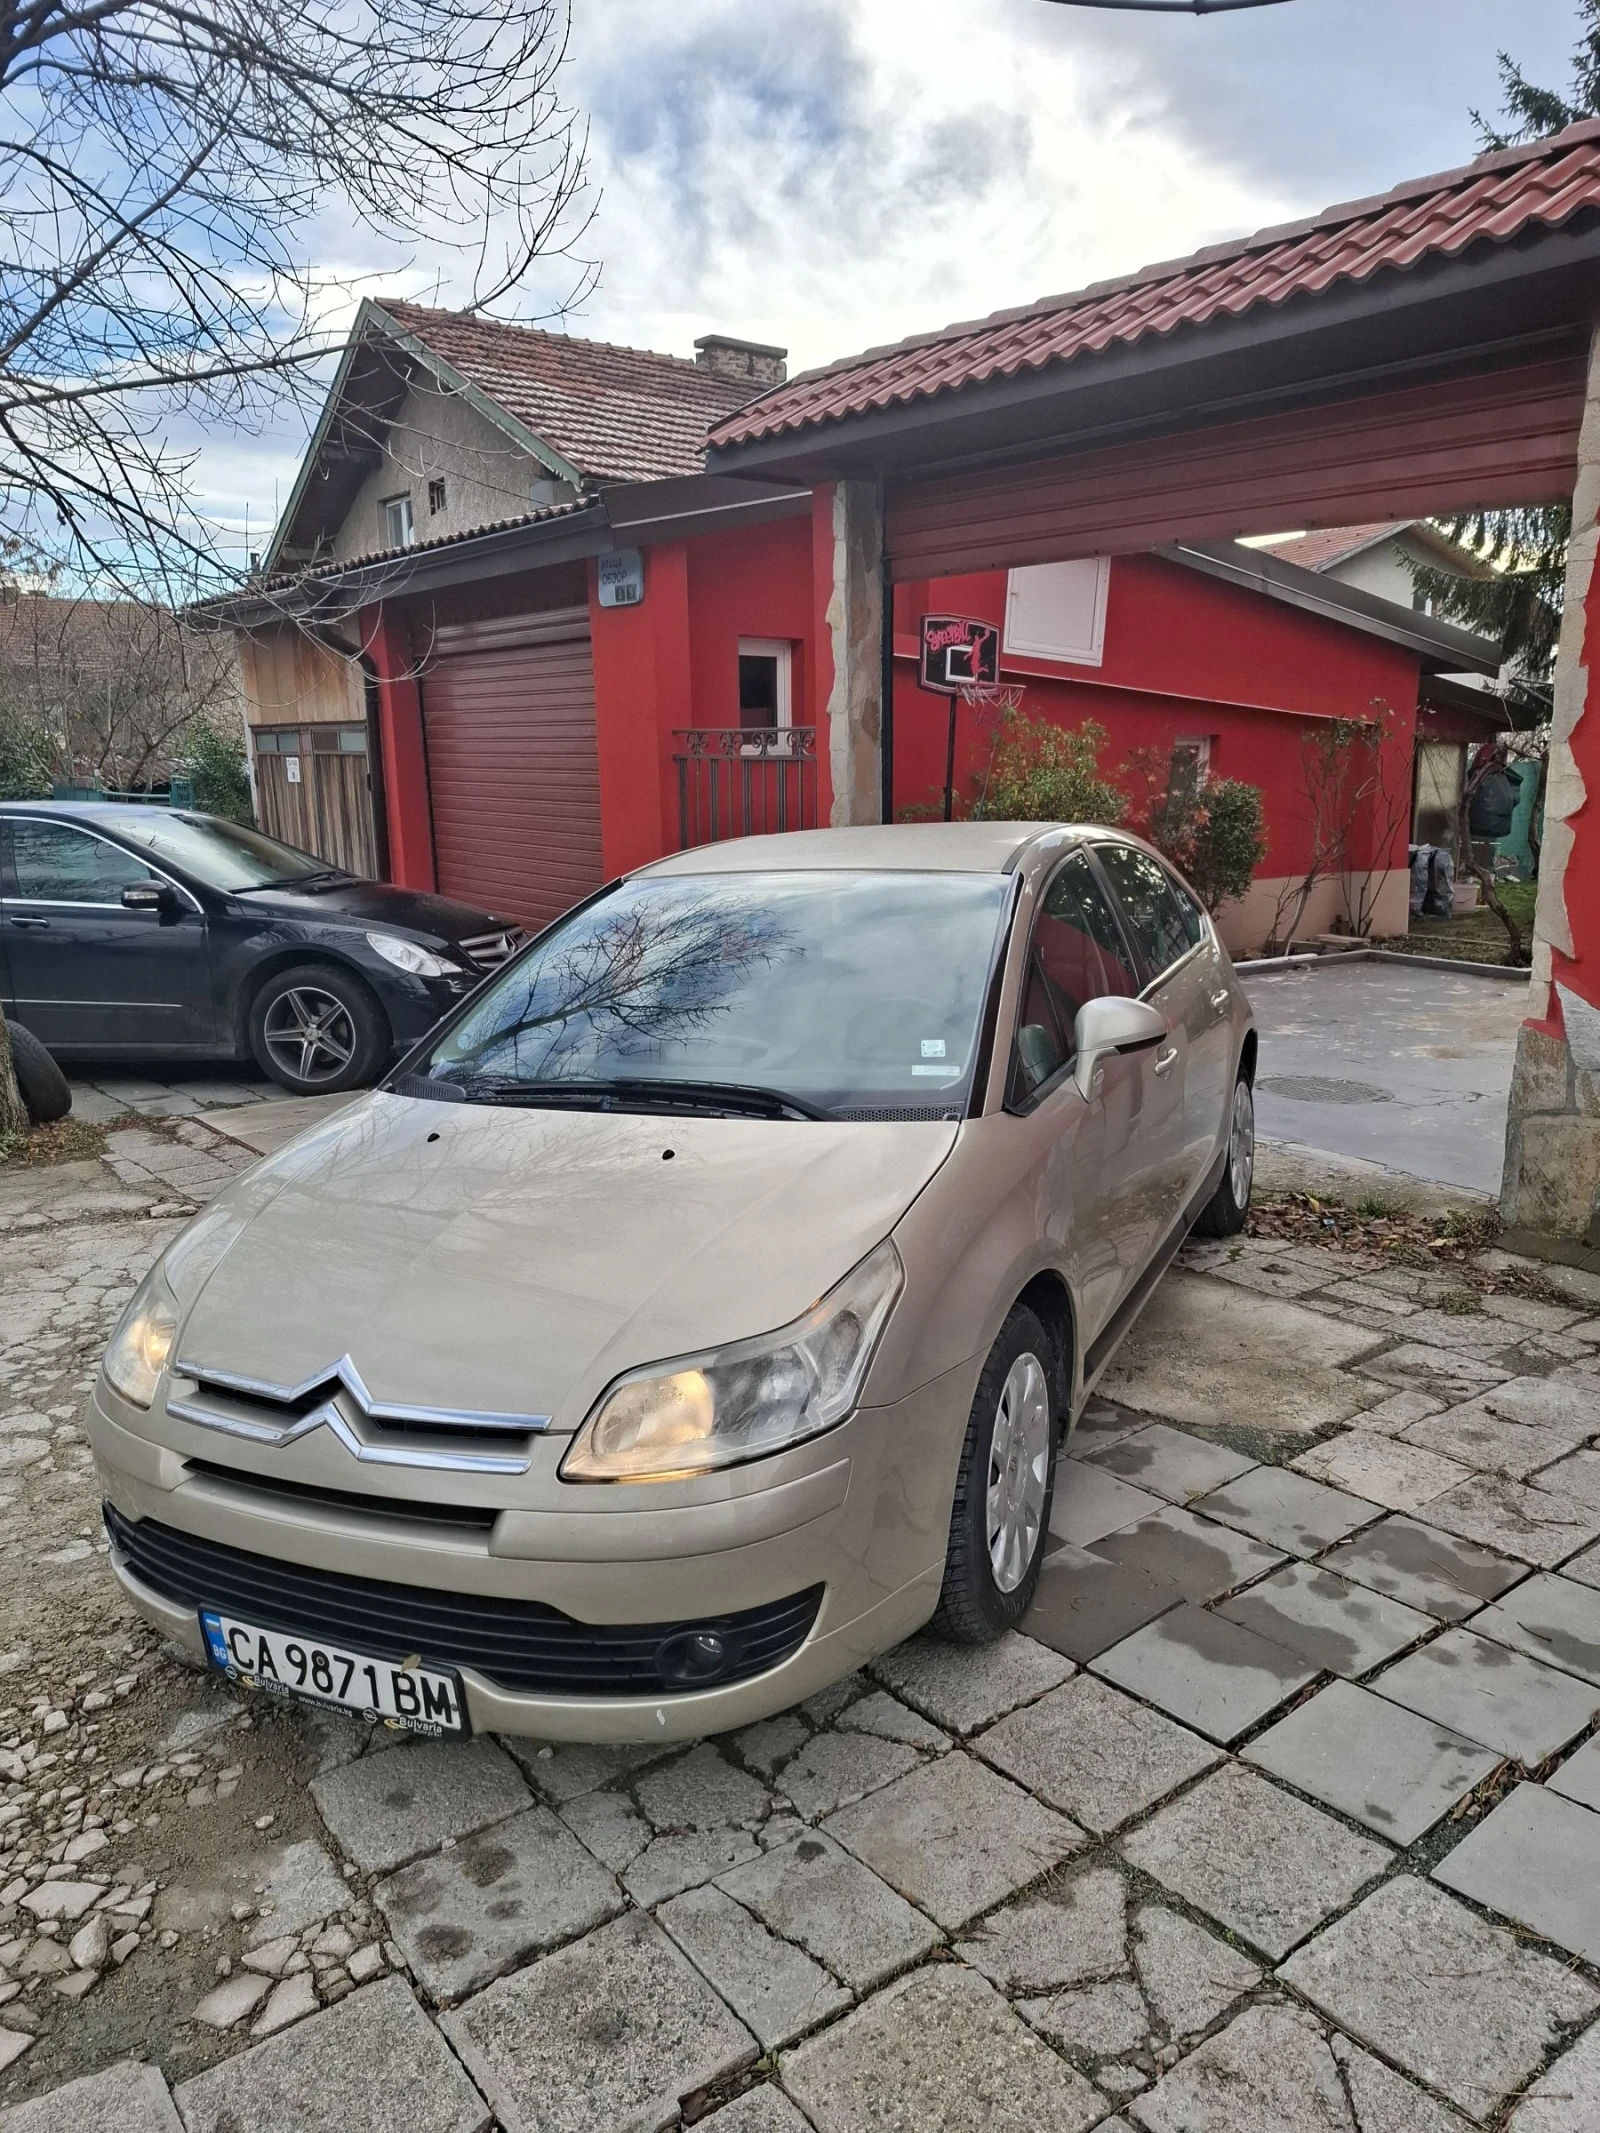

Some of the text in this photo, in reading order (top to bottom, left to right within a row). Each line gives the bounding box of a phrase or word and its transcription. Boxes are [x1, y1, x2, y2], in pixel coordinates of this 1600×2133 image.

[212, 1643, 227, 1659] BG
[254, 1675, 289, 1694] Bulvaria
[285, 1643, 380, 1709] 9871
[399, 1717, 442, 1733] Bulvaria
